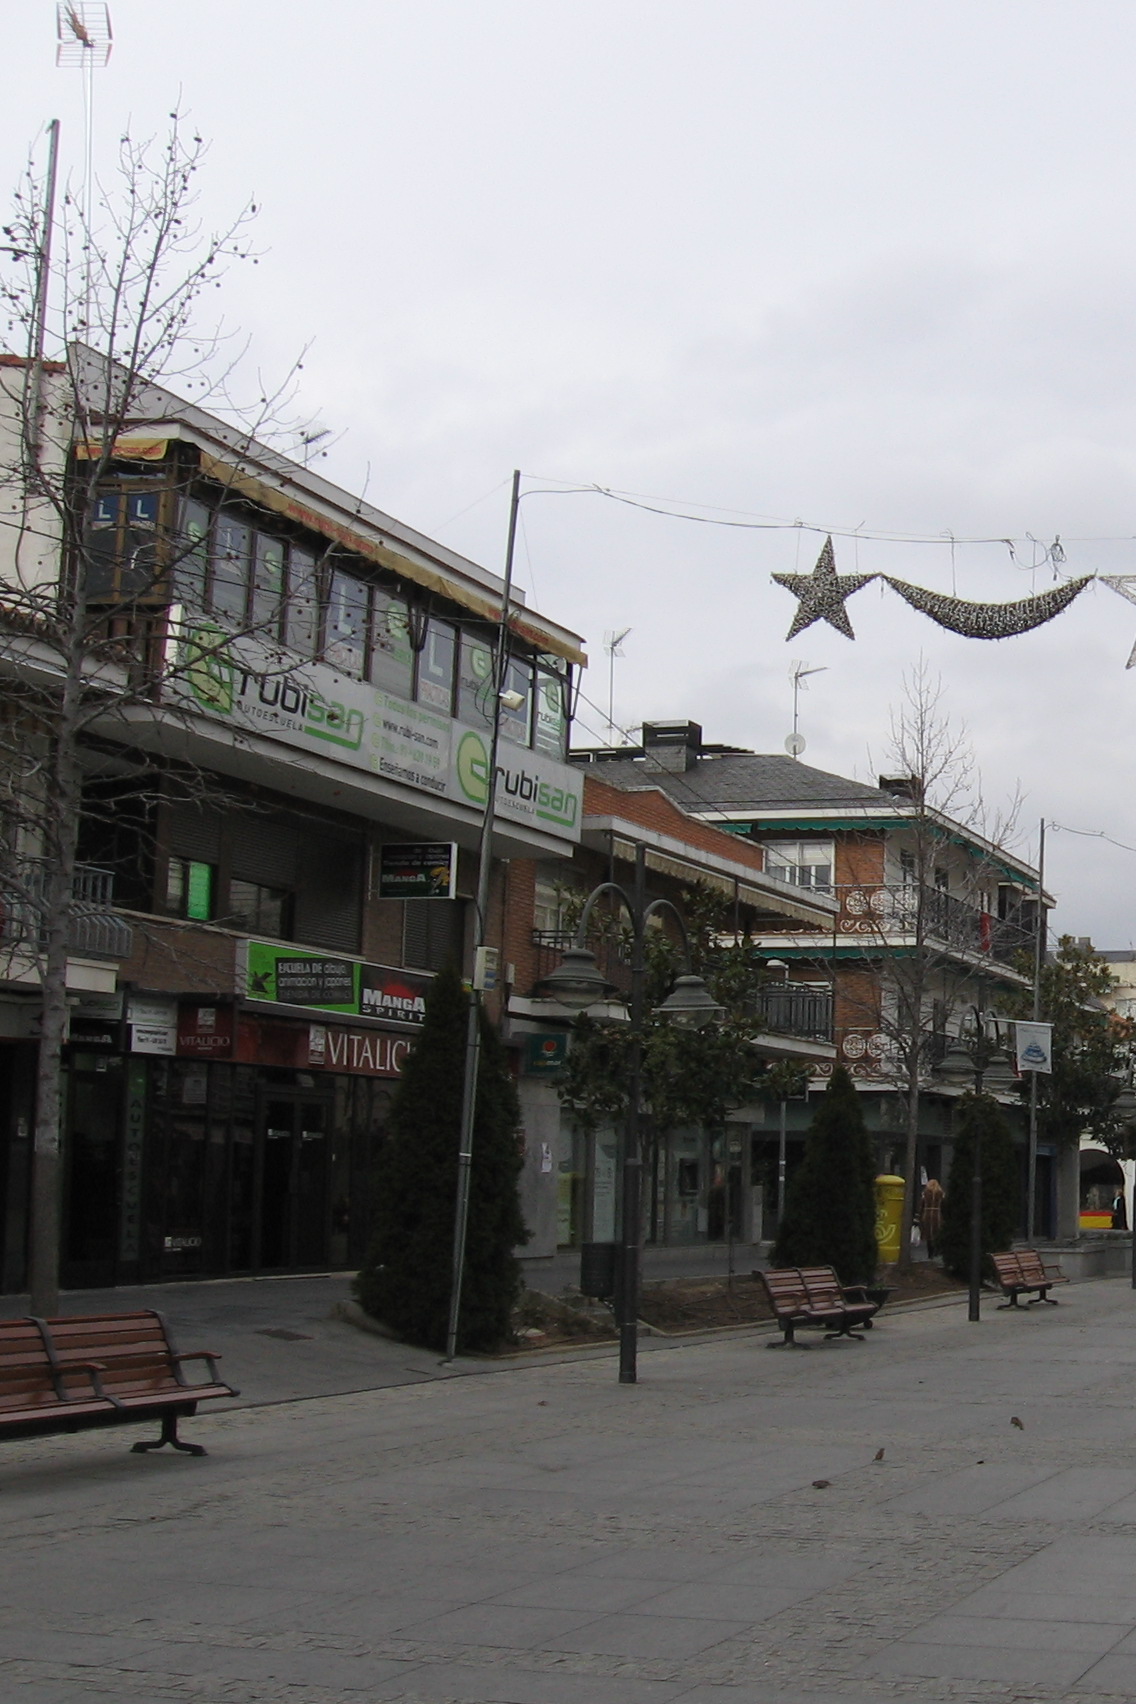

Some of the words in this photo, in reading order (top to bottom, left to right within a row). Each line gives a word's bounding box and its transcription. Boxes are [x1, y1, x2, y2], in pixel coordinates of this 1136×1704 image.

[238, 672, 365, 750] rubisan
[495, 766, 578, 826] rubisan
[278, 962, 311, 974] ESCUELA
[312, 963, 323, 974] DE
[362, 1004, 426, 1022] SPIRIT
[363, 988, 426, 1013] MANGA
[180, 1035, 231, 1047] VITALICIO
[328, 1031, 416, 1073] VITALIC
